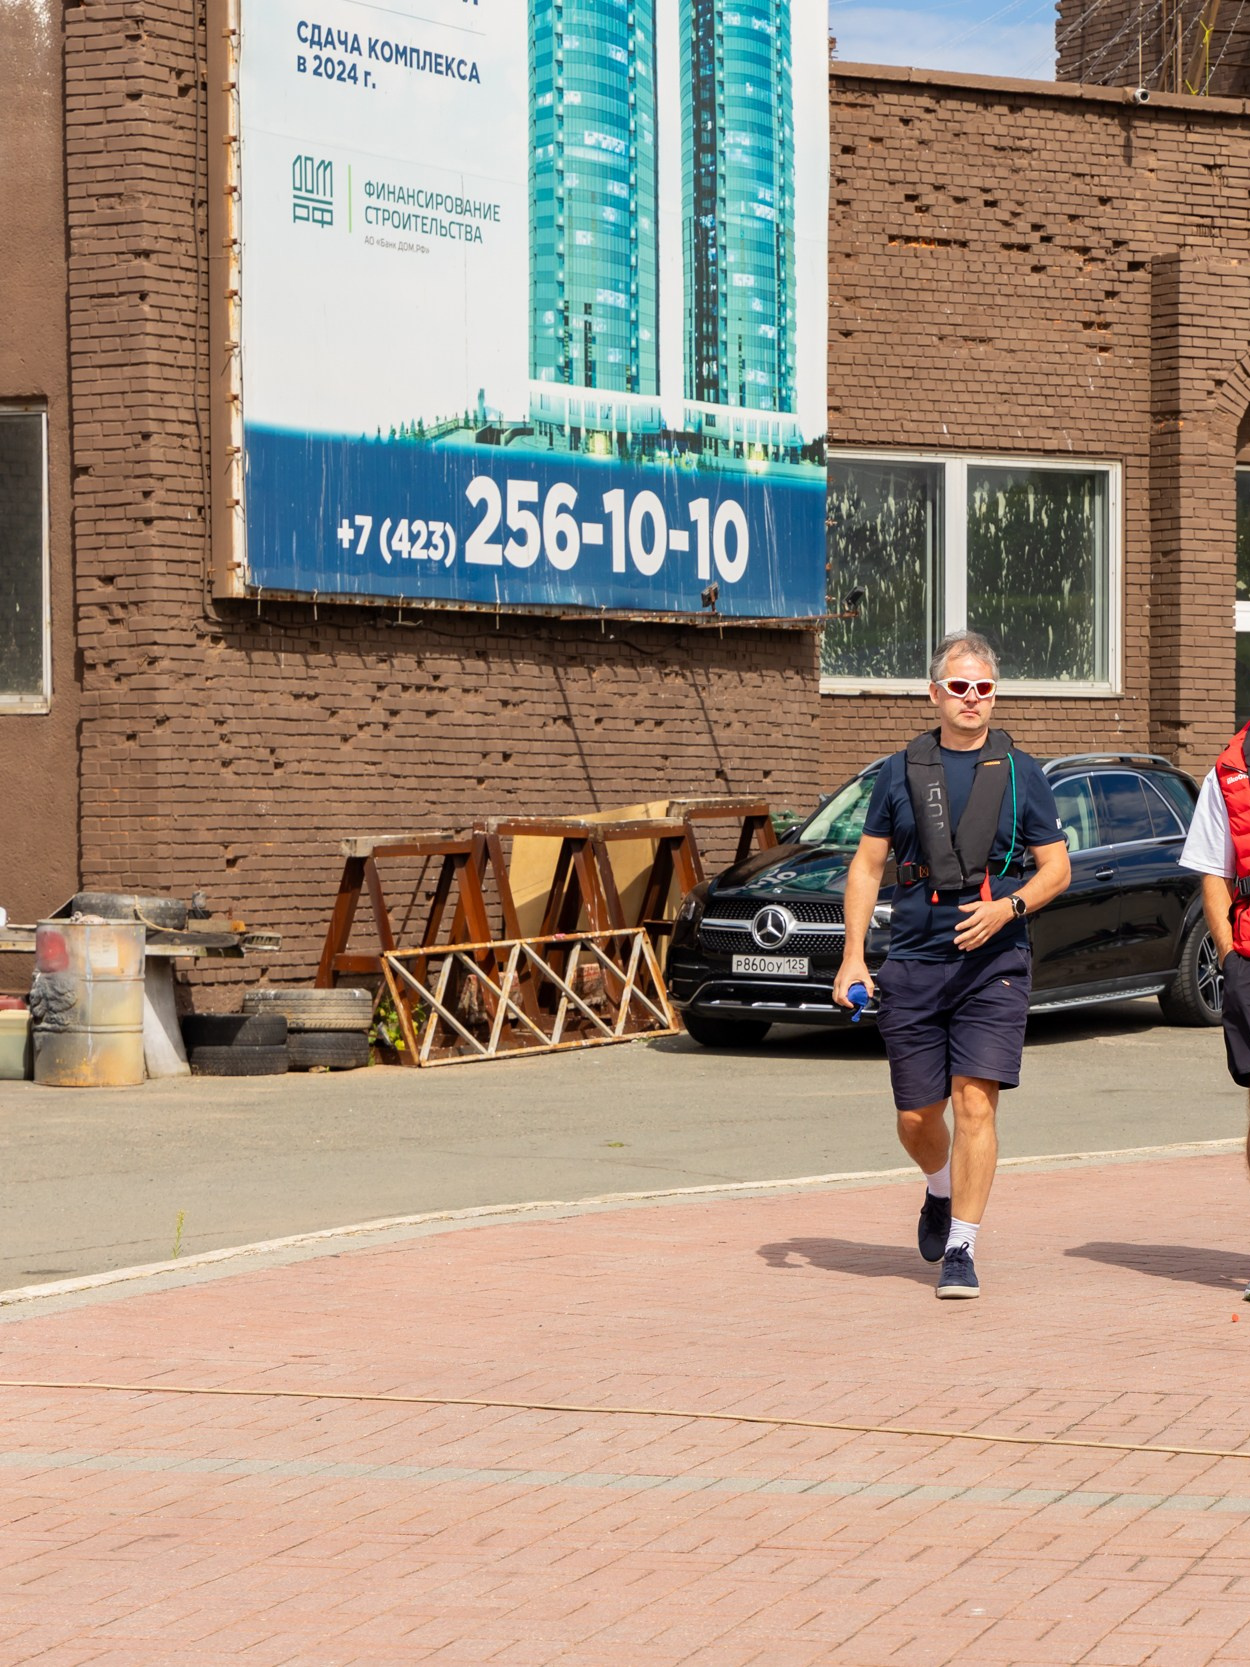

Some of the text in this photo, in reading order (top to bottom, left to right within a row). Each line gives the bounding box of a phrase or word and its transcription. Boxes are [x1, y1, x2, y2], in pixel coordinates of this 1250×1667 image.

[296, 20, 481, 84] СДАЧА КОМПЛЕКСА
[312, 54, 358, 85] 2024
[364, 70, 377, 89] г.
[292, 154, 333, 198] ДОМ
[364, 180, 501, 222] ФИНАНСИРОВАНИЕ
[364, 235, 375, 246] АО
[365, 205, 483, 244] СТРОИТЕЛЬСТВА
[337, 475, 750, 584] +7 (423) 256-10-10
[785, 958, 805, 970] 125
